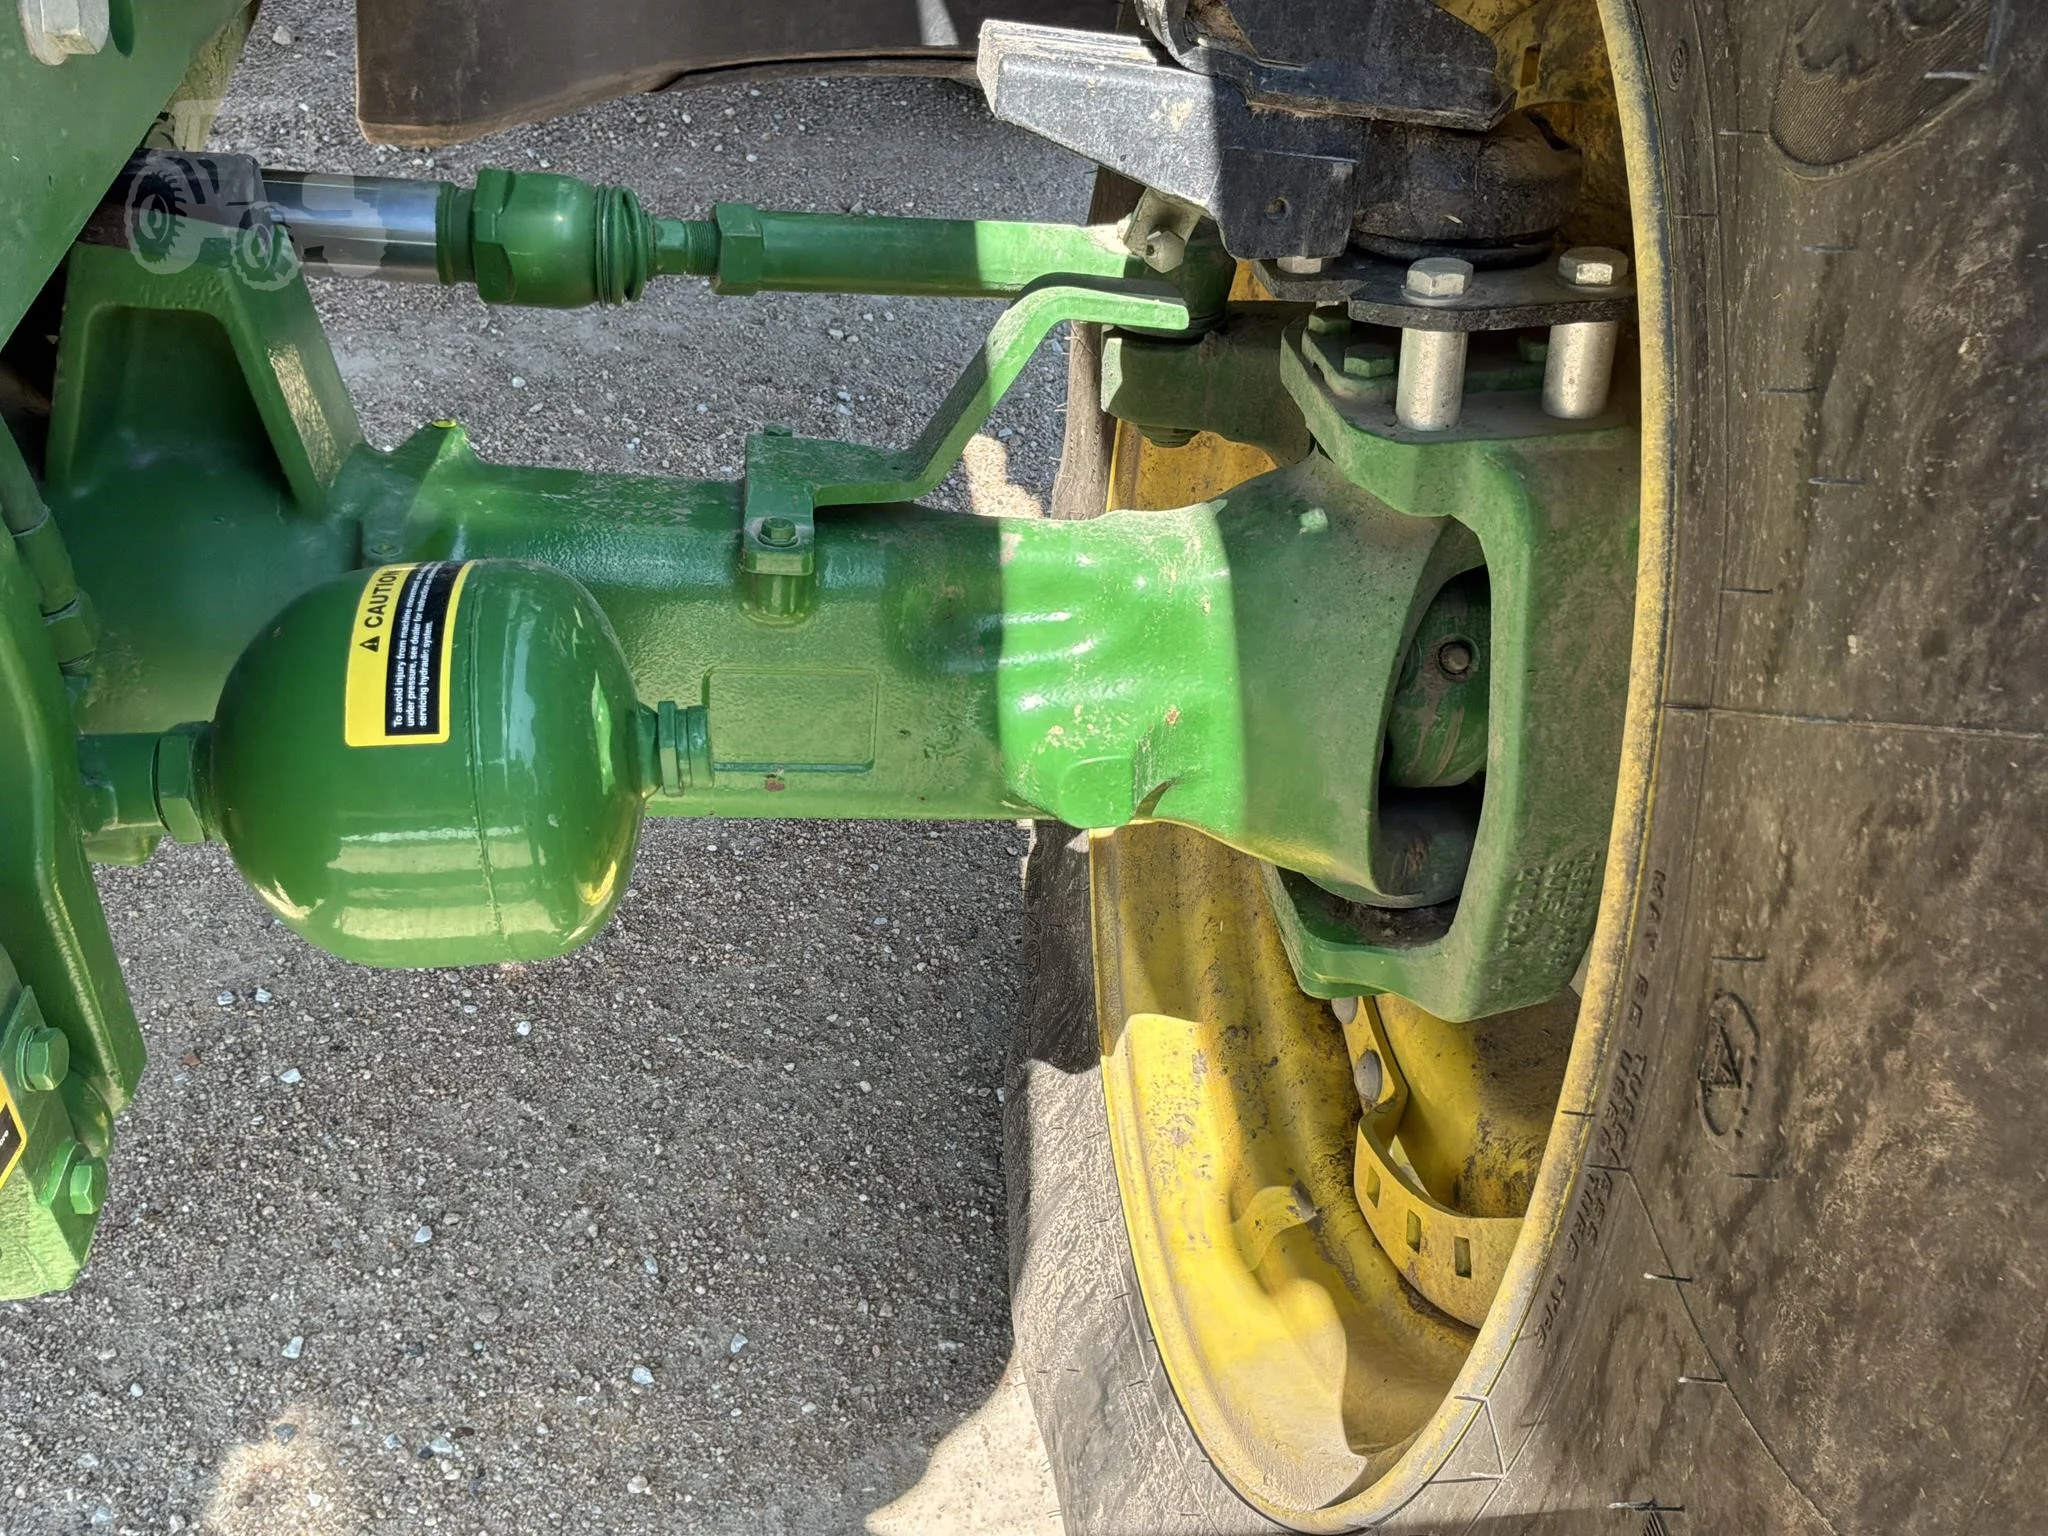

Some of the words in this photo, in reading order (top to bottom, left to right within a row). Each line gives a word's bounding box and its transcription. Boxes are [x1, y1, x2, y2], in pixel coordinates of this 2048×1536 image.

[364, 569, 400, 628] CAUTION
[407, 580, 419, 608] movement
[418, 584, 430, 611] instruction
[401, 609, 412, 639] machine
[414, 611, 423, 623] for
[411, 623, 421, 645] dealer
[425, 620, 433, 647] system.
[397, 640, 407, 660] from
[410, 644, 418, 660] see
[394, 661, 407, 685] injury
[407, 661, 417, 699] pressure,
[420, 648, 430, 686] hydraulic
[393, 687, 403, 712] avoid
[419, 687, 429, 727] servicing
[393, 714, 402, 728] To
[406, 702, 415, 727] under
